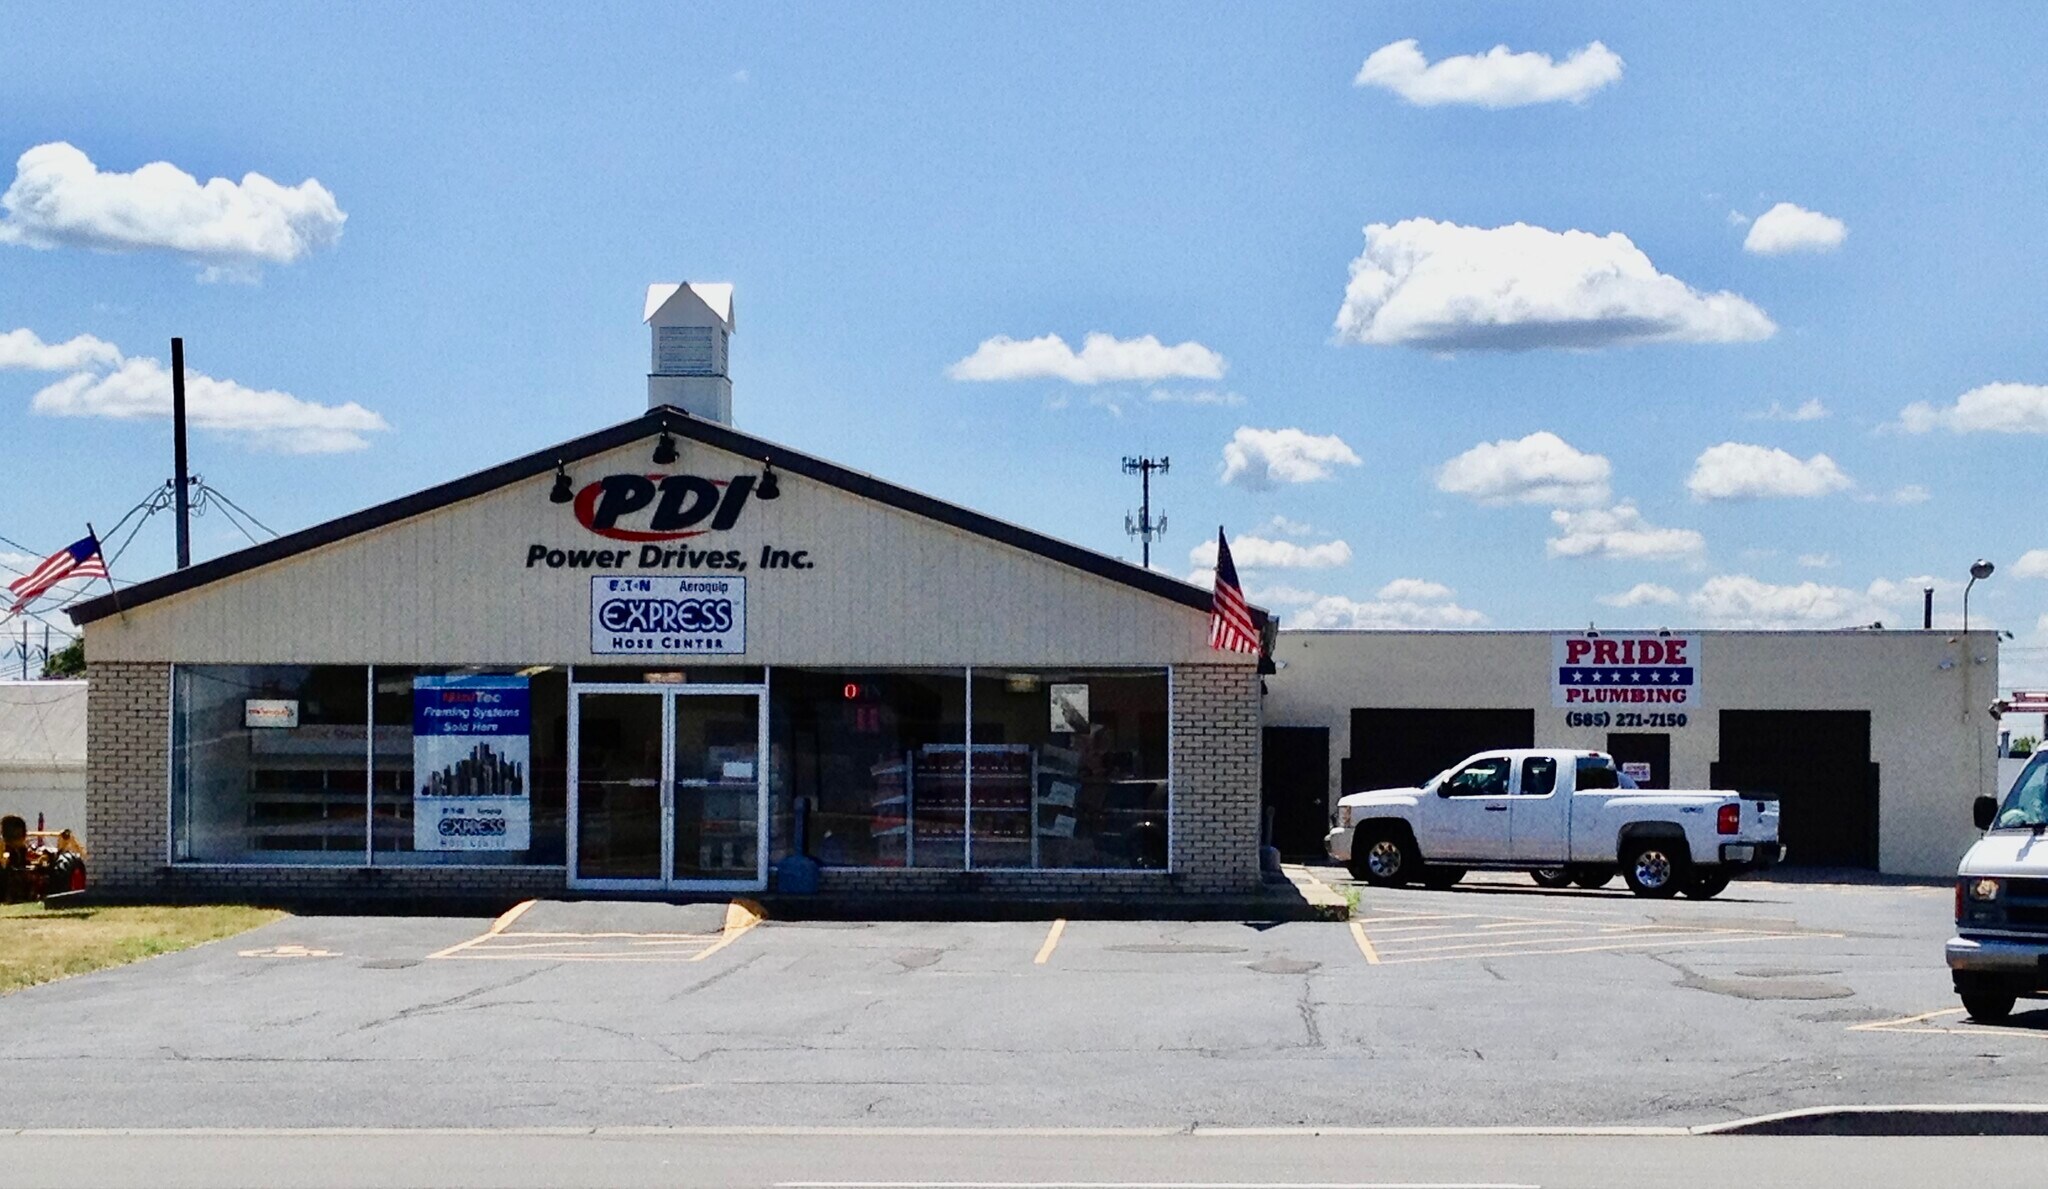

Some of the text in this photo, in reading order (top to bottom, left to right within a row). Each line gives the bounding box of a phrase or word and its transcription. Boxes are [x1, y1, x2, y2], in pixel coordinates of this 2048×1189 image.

[591, 474, 757, 531] PDI
[526, 544, 814, 572] Power Drives, Inc.
[679, 579, 729, 594] Aeroquip
[599, 598, 733, 632] EXPRESS
[612, 637, 723, 649] HOSE CENTER
[1566, 640, 1687, 664] PRIDE
[1566, 688, 1687, 703] PLUMBING
[423, 706, 520, 719] Framing Systems
[1565, 711, 1688, 728] (585) 271-7150
[443, 722, 498, 732] Sold Here
